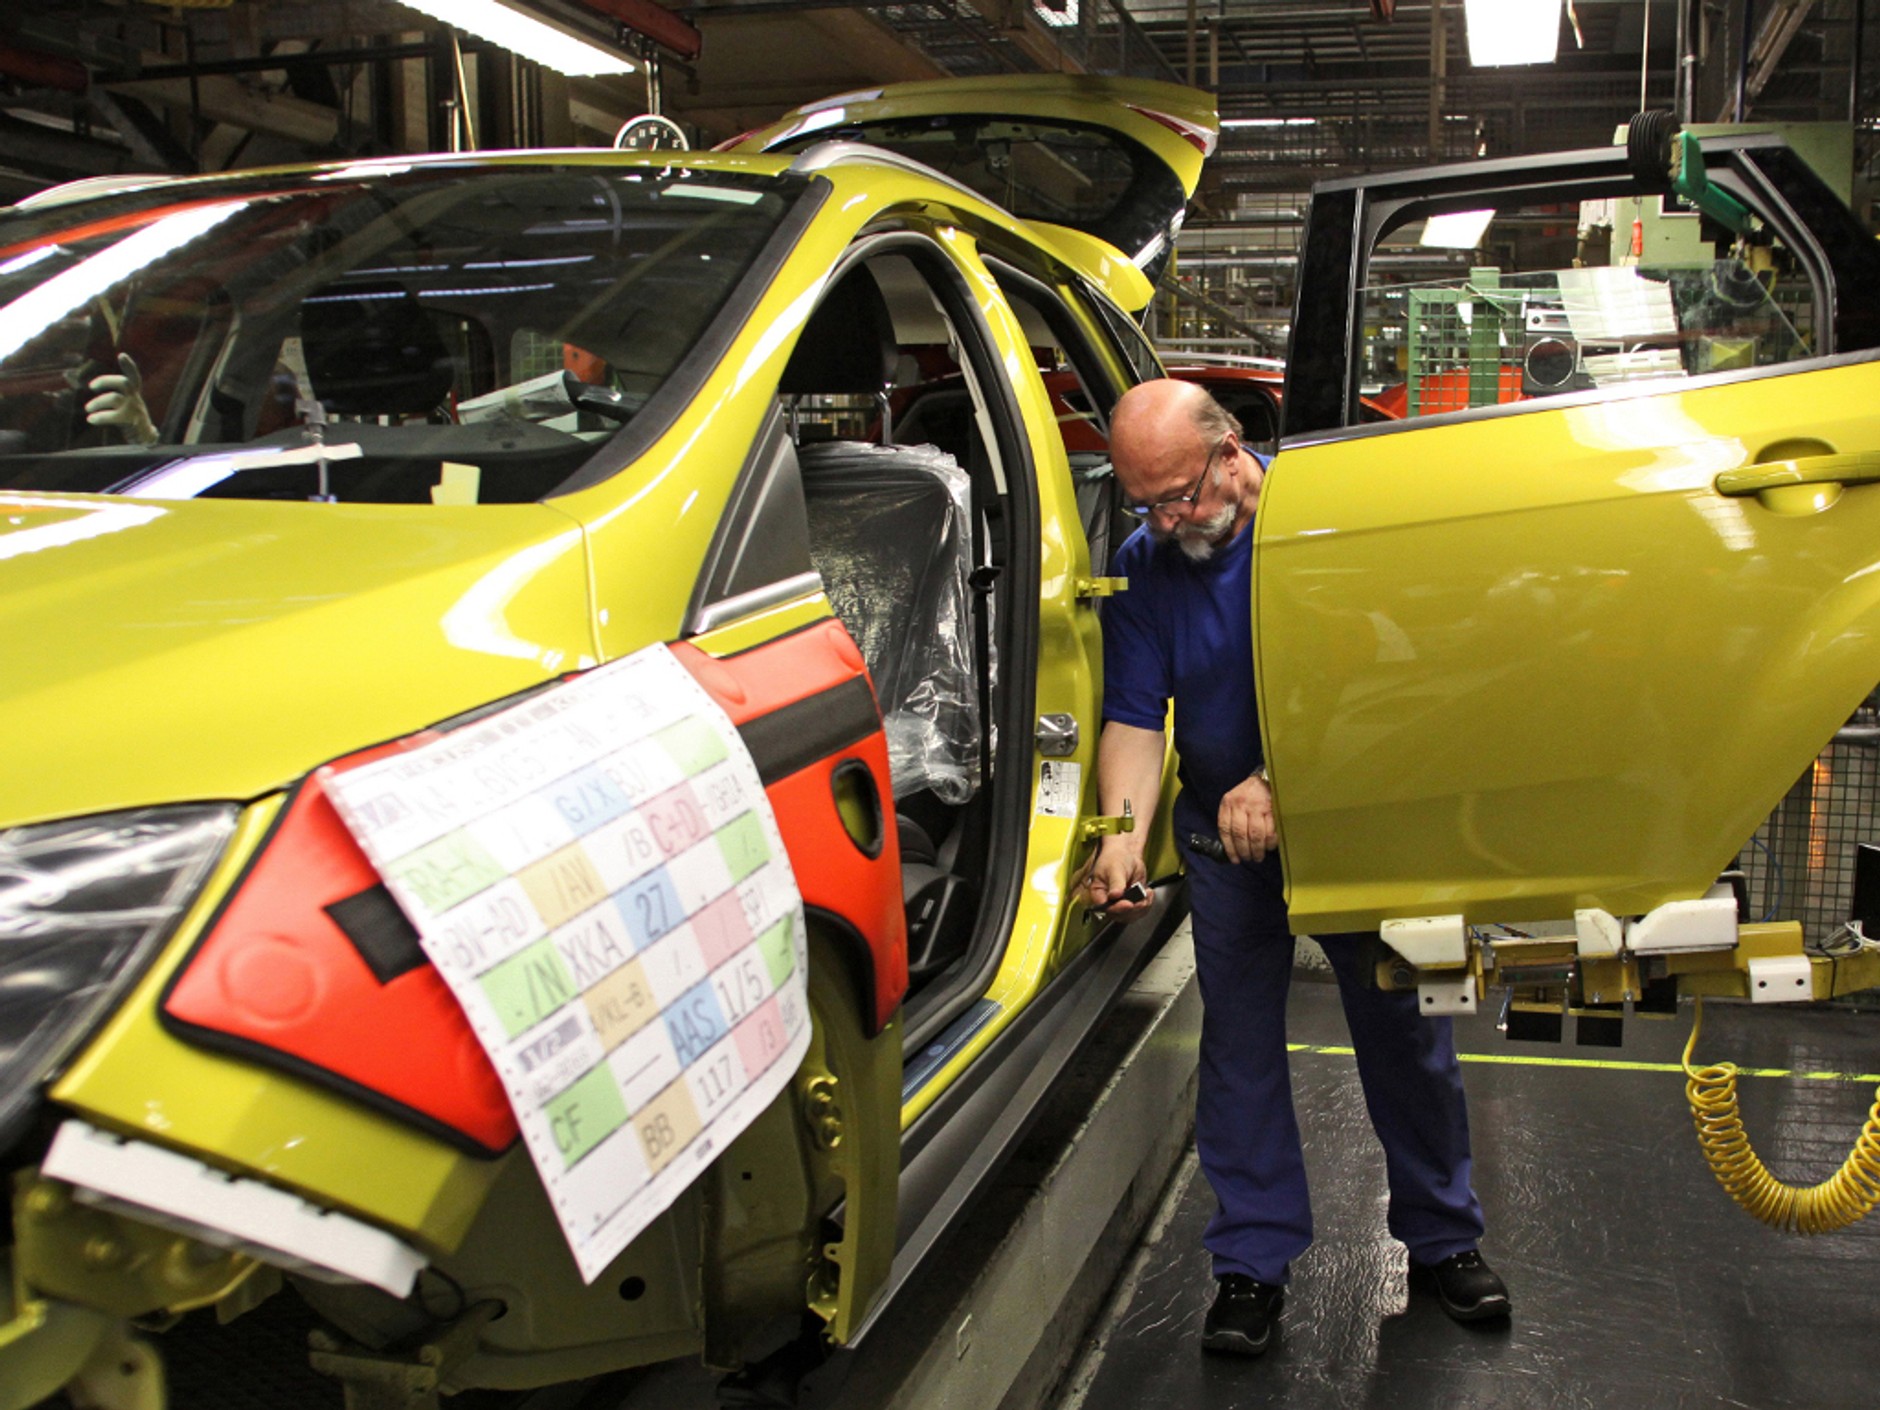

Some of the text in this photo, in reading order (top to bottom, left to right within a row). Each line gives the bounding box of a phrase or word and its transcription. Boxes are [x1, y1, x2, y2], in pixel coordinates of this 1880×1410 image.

[555, 781, 617, 824] G/X
[634, 883, 667, 939] 27
[560, 919, 626, 987] XKA
[717, 959, 765, 1024] 1/5
[668, 999, 718, 1069] AAS
[696, 1054, 736, 1108] 117
[549, 1103, 583, 1156] CF
[641, 1111, 676, 1159] BB
